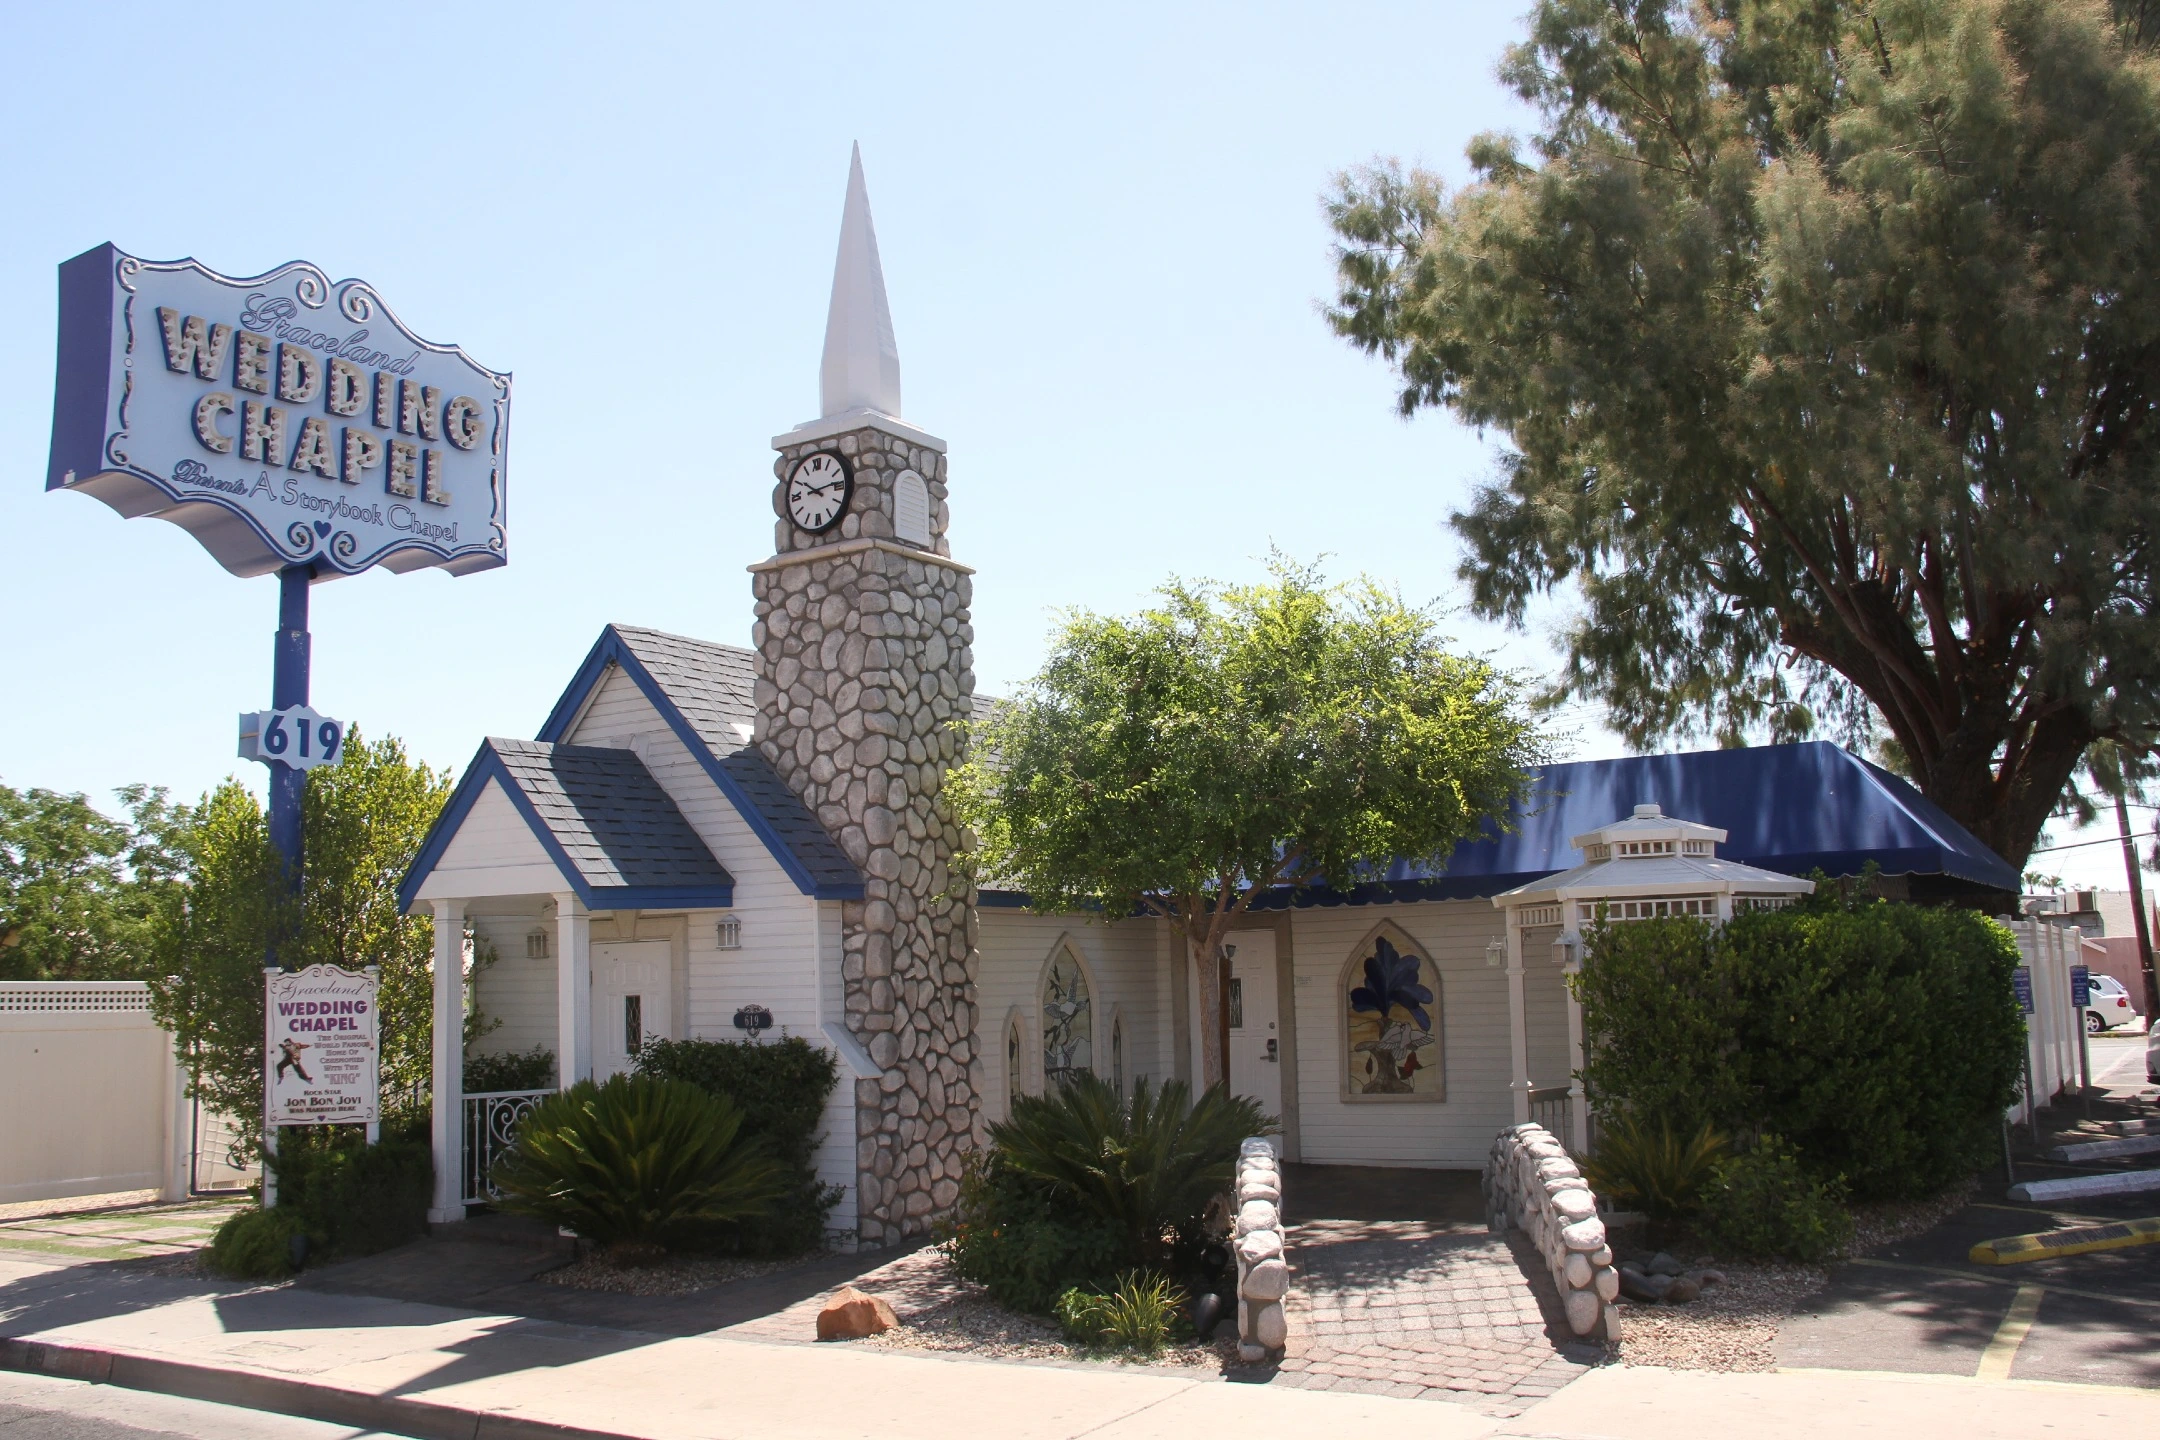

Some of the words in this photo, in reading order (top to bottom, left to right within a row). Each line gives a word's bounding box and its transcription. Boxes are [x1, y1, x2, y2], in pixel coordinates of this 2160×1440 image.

[240, 293, 420, 376] Graceland
[155, 306, 486, 451] WEDDING
[191, 392, 452, 508] CHAPEL
[172, 458, 248, 496] Presents
[249, 471, 277, 501] A
[281, 478, 383, 526] Storybook
[387, 504, 458, 542] Chapel
[264, 714, 340, 760] 619
[278, 1000, 368, 1016] WEDDING
[279, 979, 366, 1001] Graceland
[289, 1017, 358, 1032] CHAPEL
[744, 1015, 759, 1027] 619
